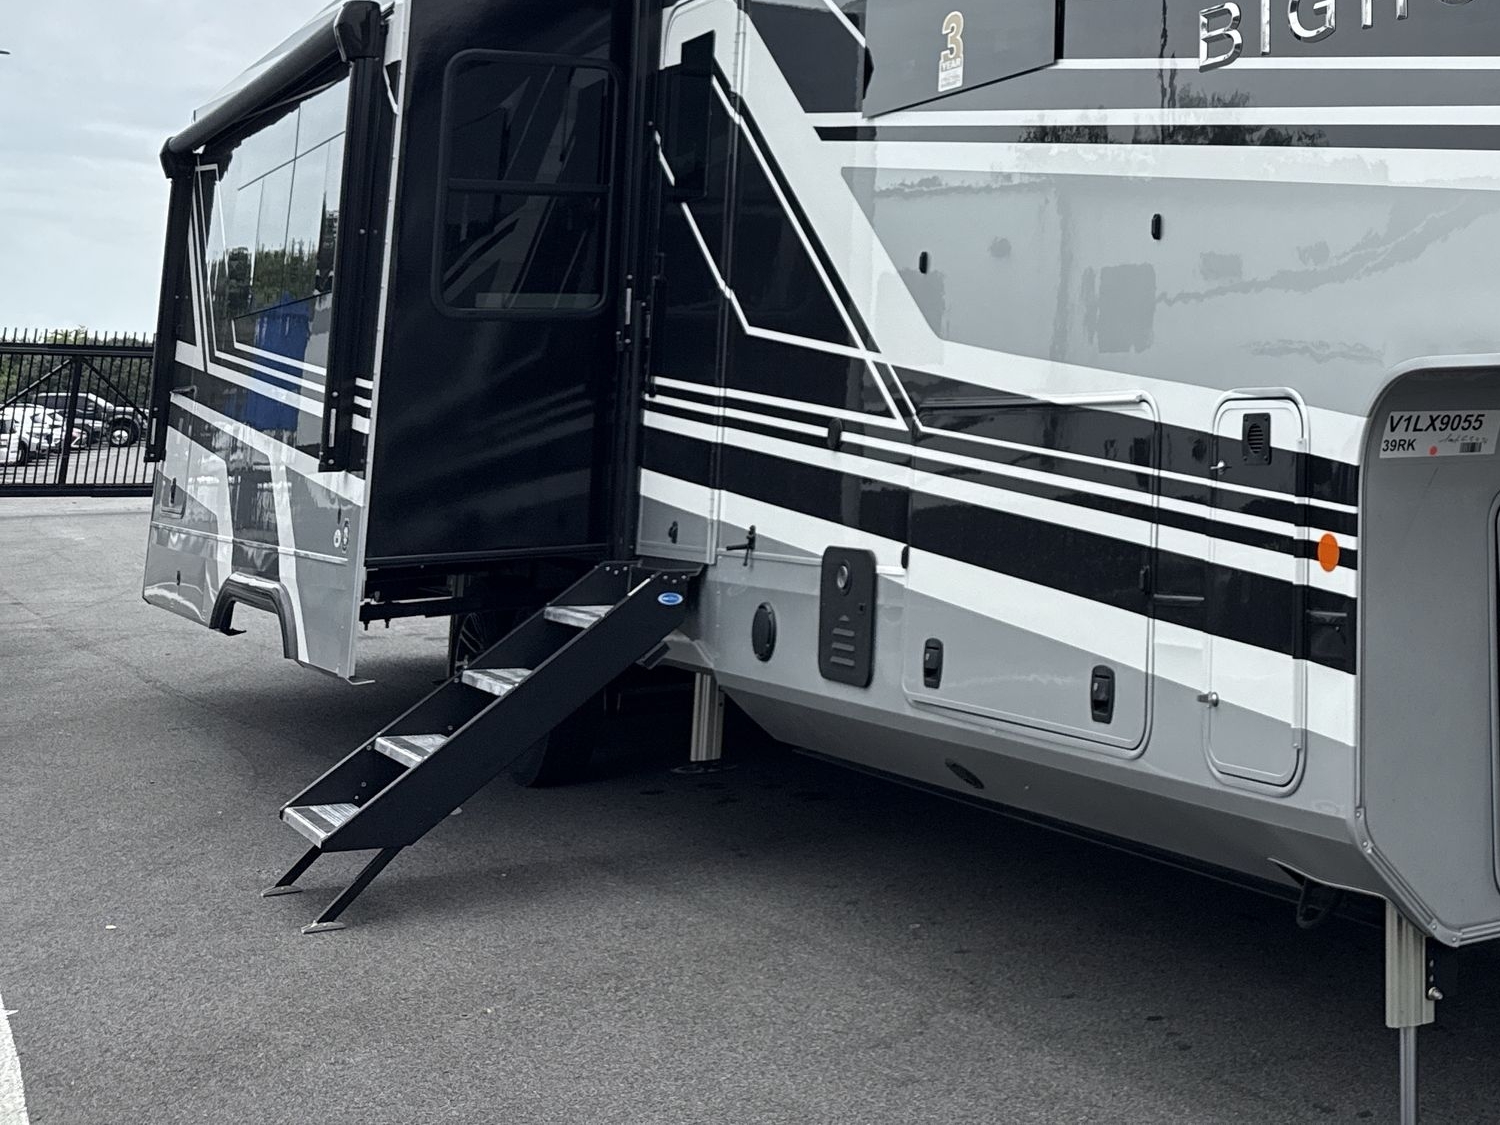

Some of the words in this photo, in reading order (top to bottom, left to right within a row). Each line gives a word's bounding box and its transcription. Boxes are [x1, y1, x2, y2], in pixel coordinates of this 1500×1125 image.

[942, 11, 964, 62] 3
[1390, 414, 1486, 432] V1LX9055
[1382, 438, 1416, 452] 39RK
